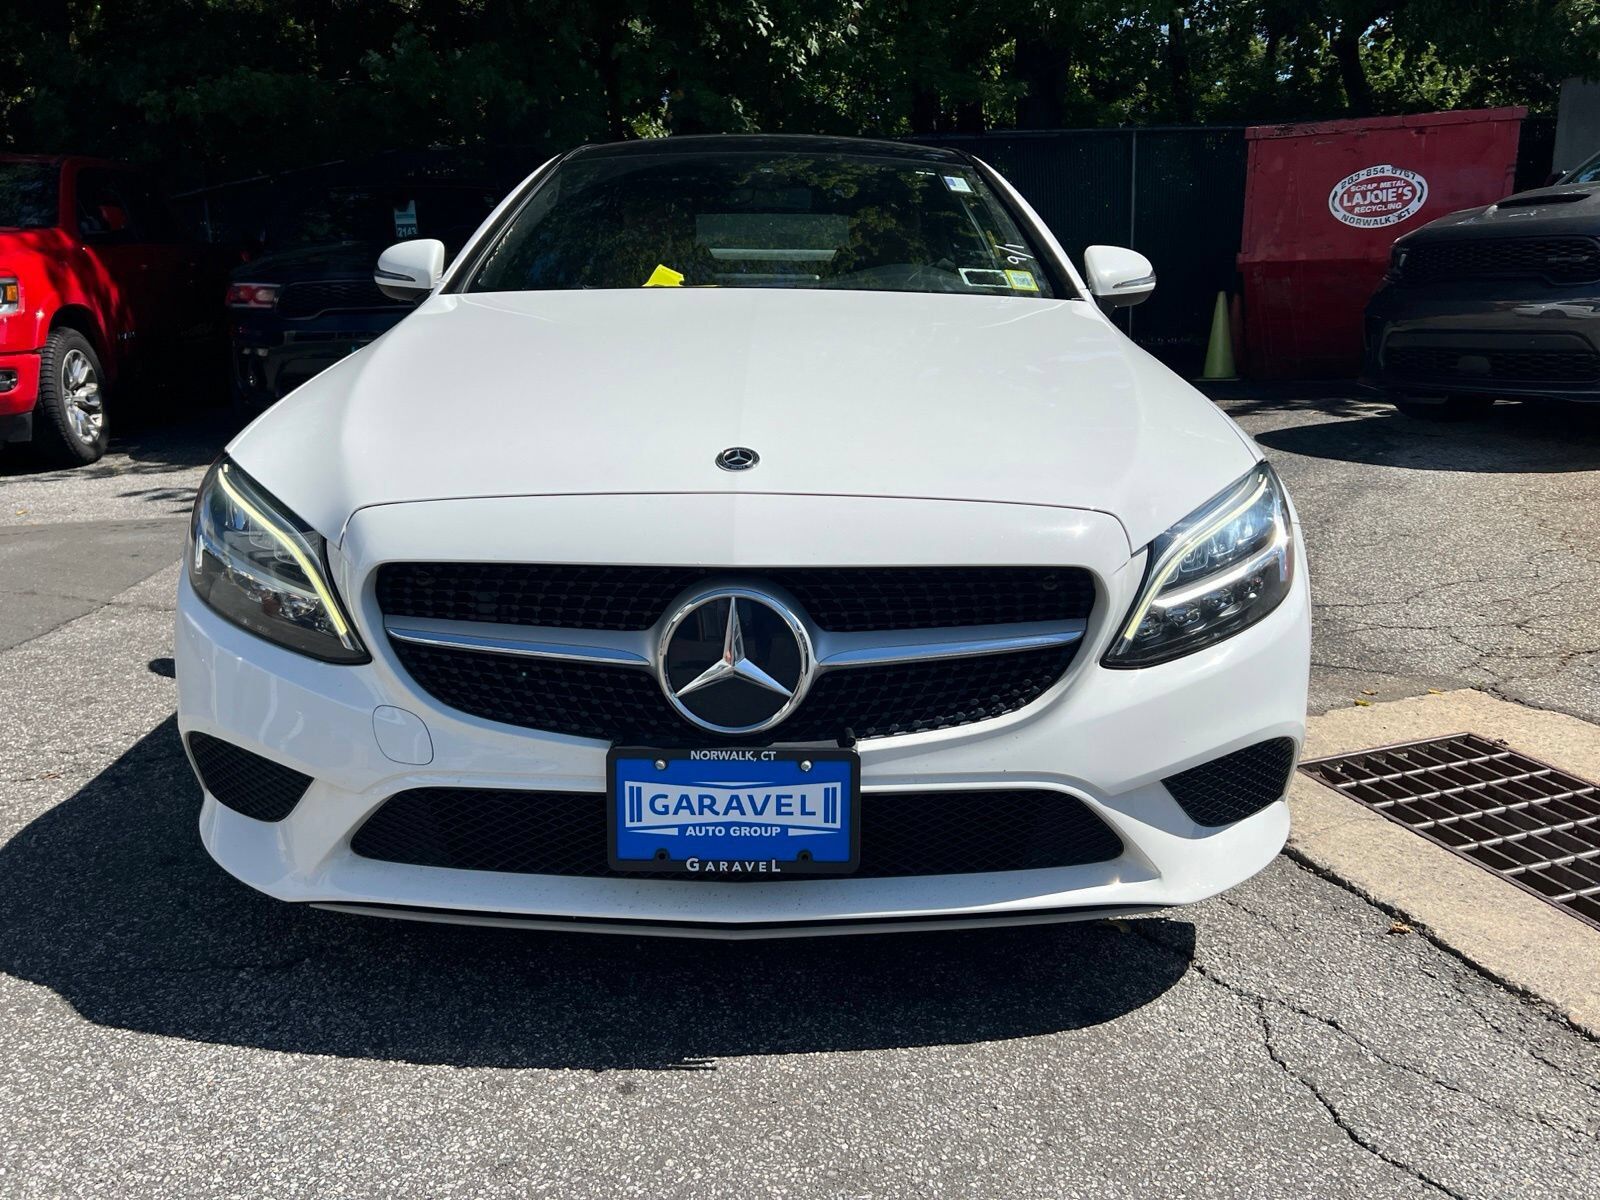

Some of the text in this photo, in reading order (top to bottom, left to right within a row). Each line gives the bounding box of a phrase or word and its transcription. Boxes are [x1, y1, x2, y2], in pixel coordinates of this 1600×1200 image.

[1350, 180, 1406, 192] SCRAP METAL
[1343, 186, 1413, 207] LAJOIE'S
[1354, 202, 1402, 214] RECYCLING
[690, 750, 777, 762] NORWALK, CT
[648, 793, 817, 816] GARAVEL
[685, 826, 781, 837] AUTO GROUP
[685, 857, 781, 872] GARAVEL
